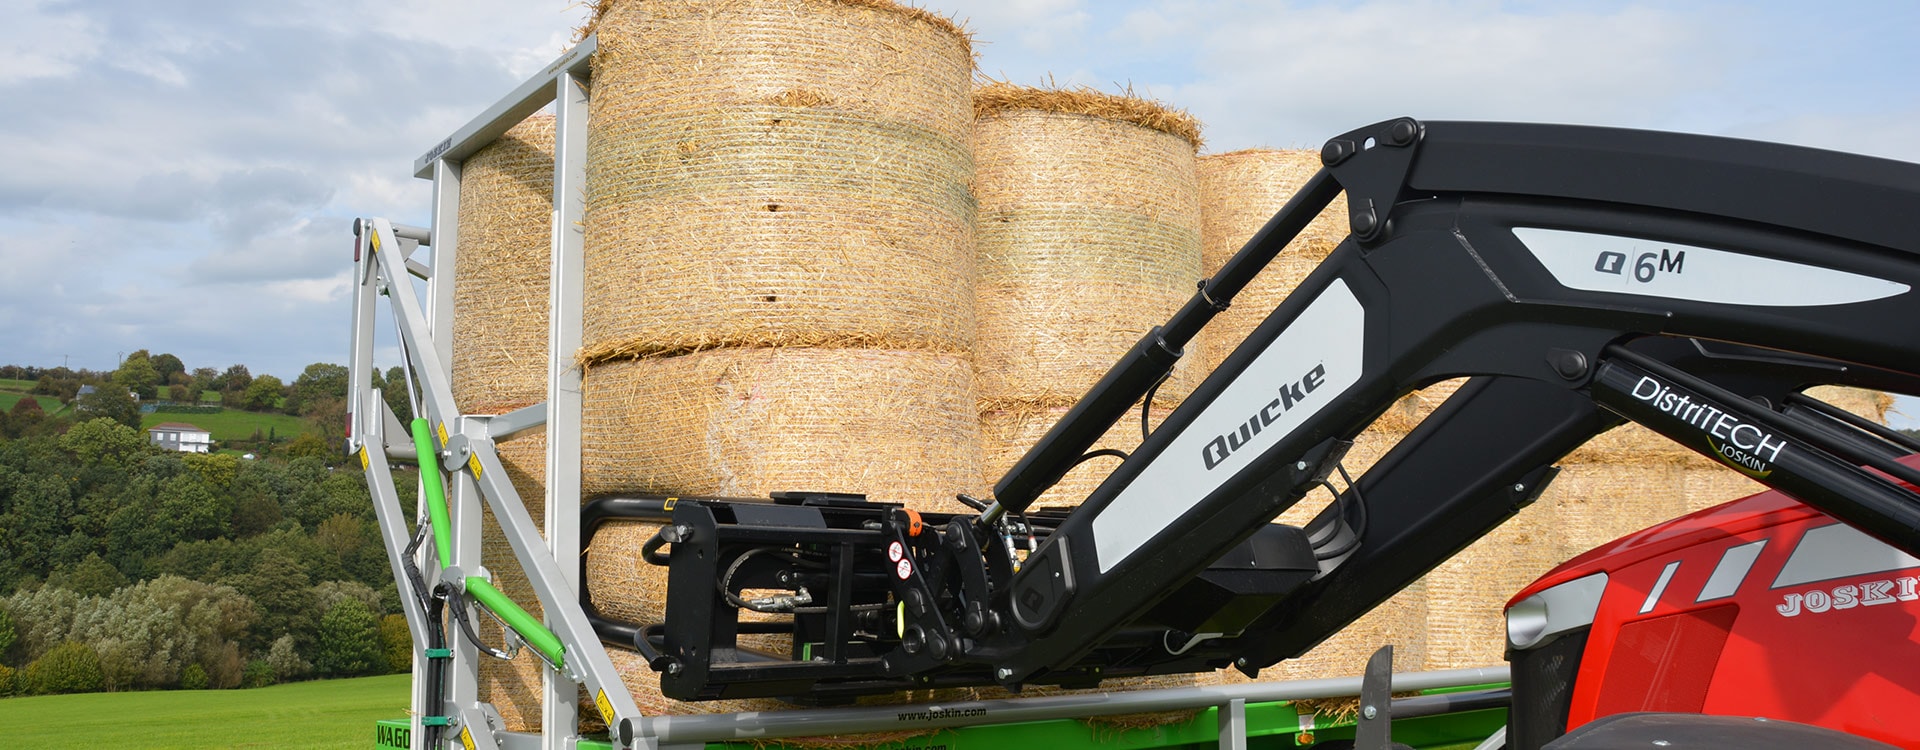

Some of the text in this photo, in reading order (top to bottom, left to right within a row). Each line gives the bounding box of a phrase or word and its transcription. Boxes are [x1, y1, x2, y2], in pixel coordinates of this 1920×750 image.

[1202, 363, 1326, 471] Quicke
[1631, 375, 1788, 464] DistriTECH
[1719, 443, 1767, 473] JOSKIN
[1776, 576, 1920, 618] JOSKI
[897, 707, 987, 722] www.joskin.com
